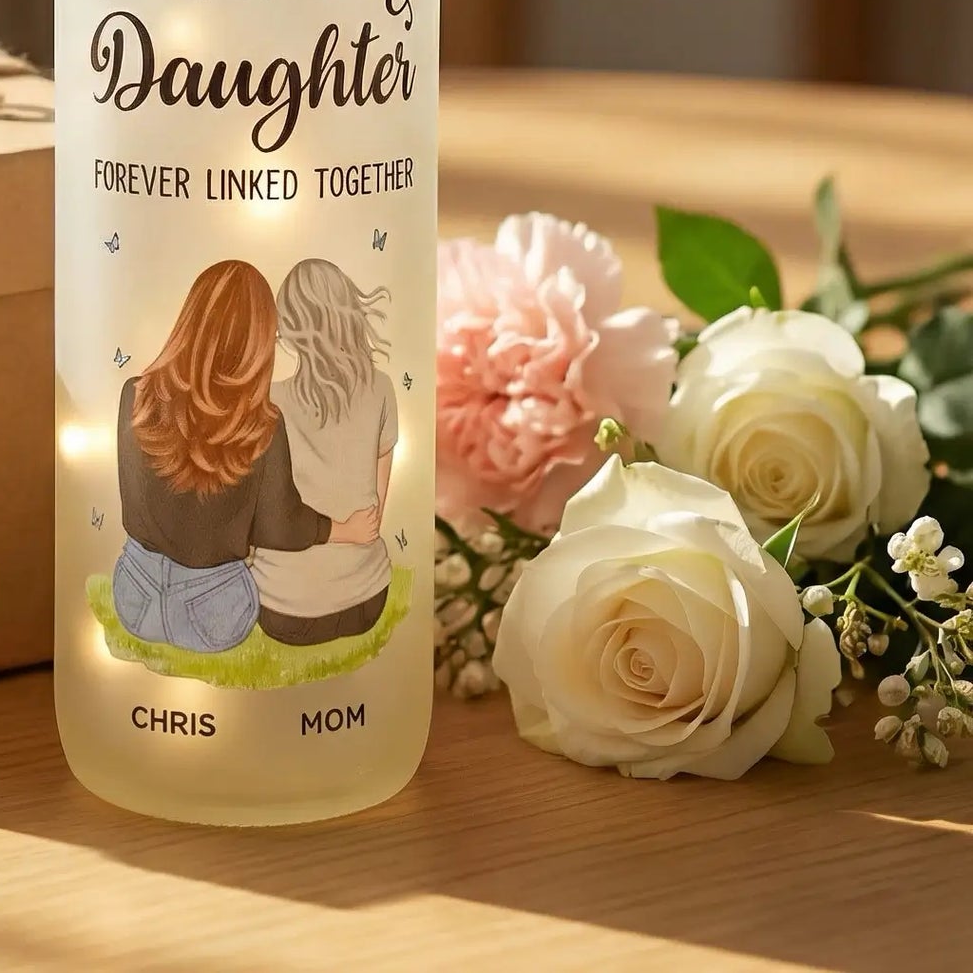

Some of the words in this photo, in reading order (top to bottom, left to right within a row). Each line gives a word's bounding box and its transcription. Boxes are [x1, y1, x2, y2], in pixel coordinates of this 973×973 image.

[90, 11, 417, 154] Daughter
[94, 158, 190, 200] FOREVER
[206, 168, 299, 201] LINKED
[313, 157, 414, 199] TOGETHER
[131, 705, 217, 737] CHRIS
[300, 702, 366, 737] MOM
